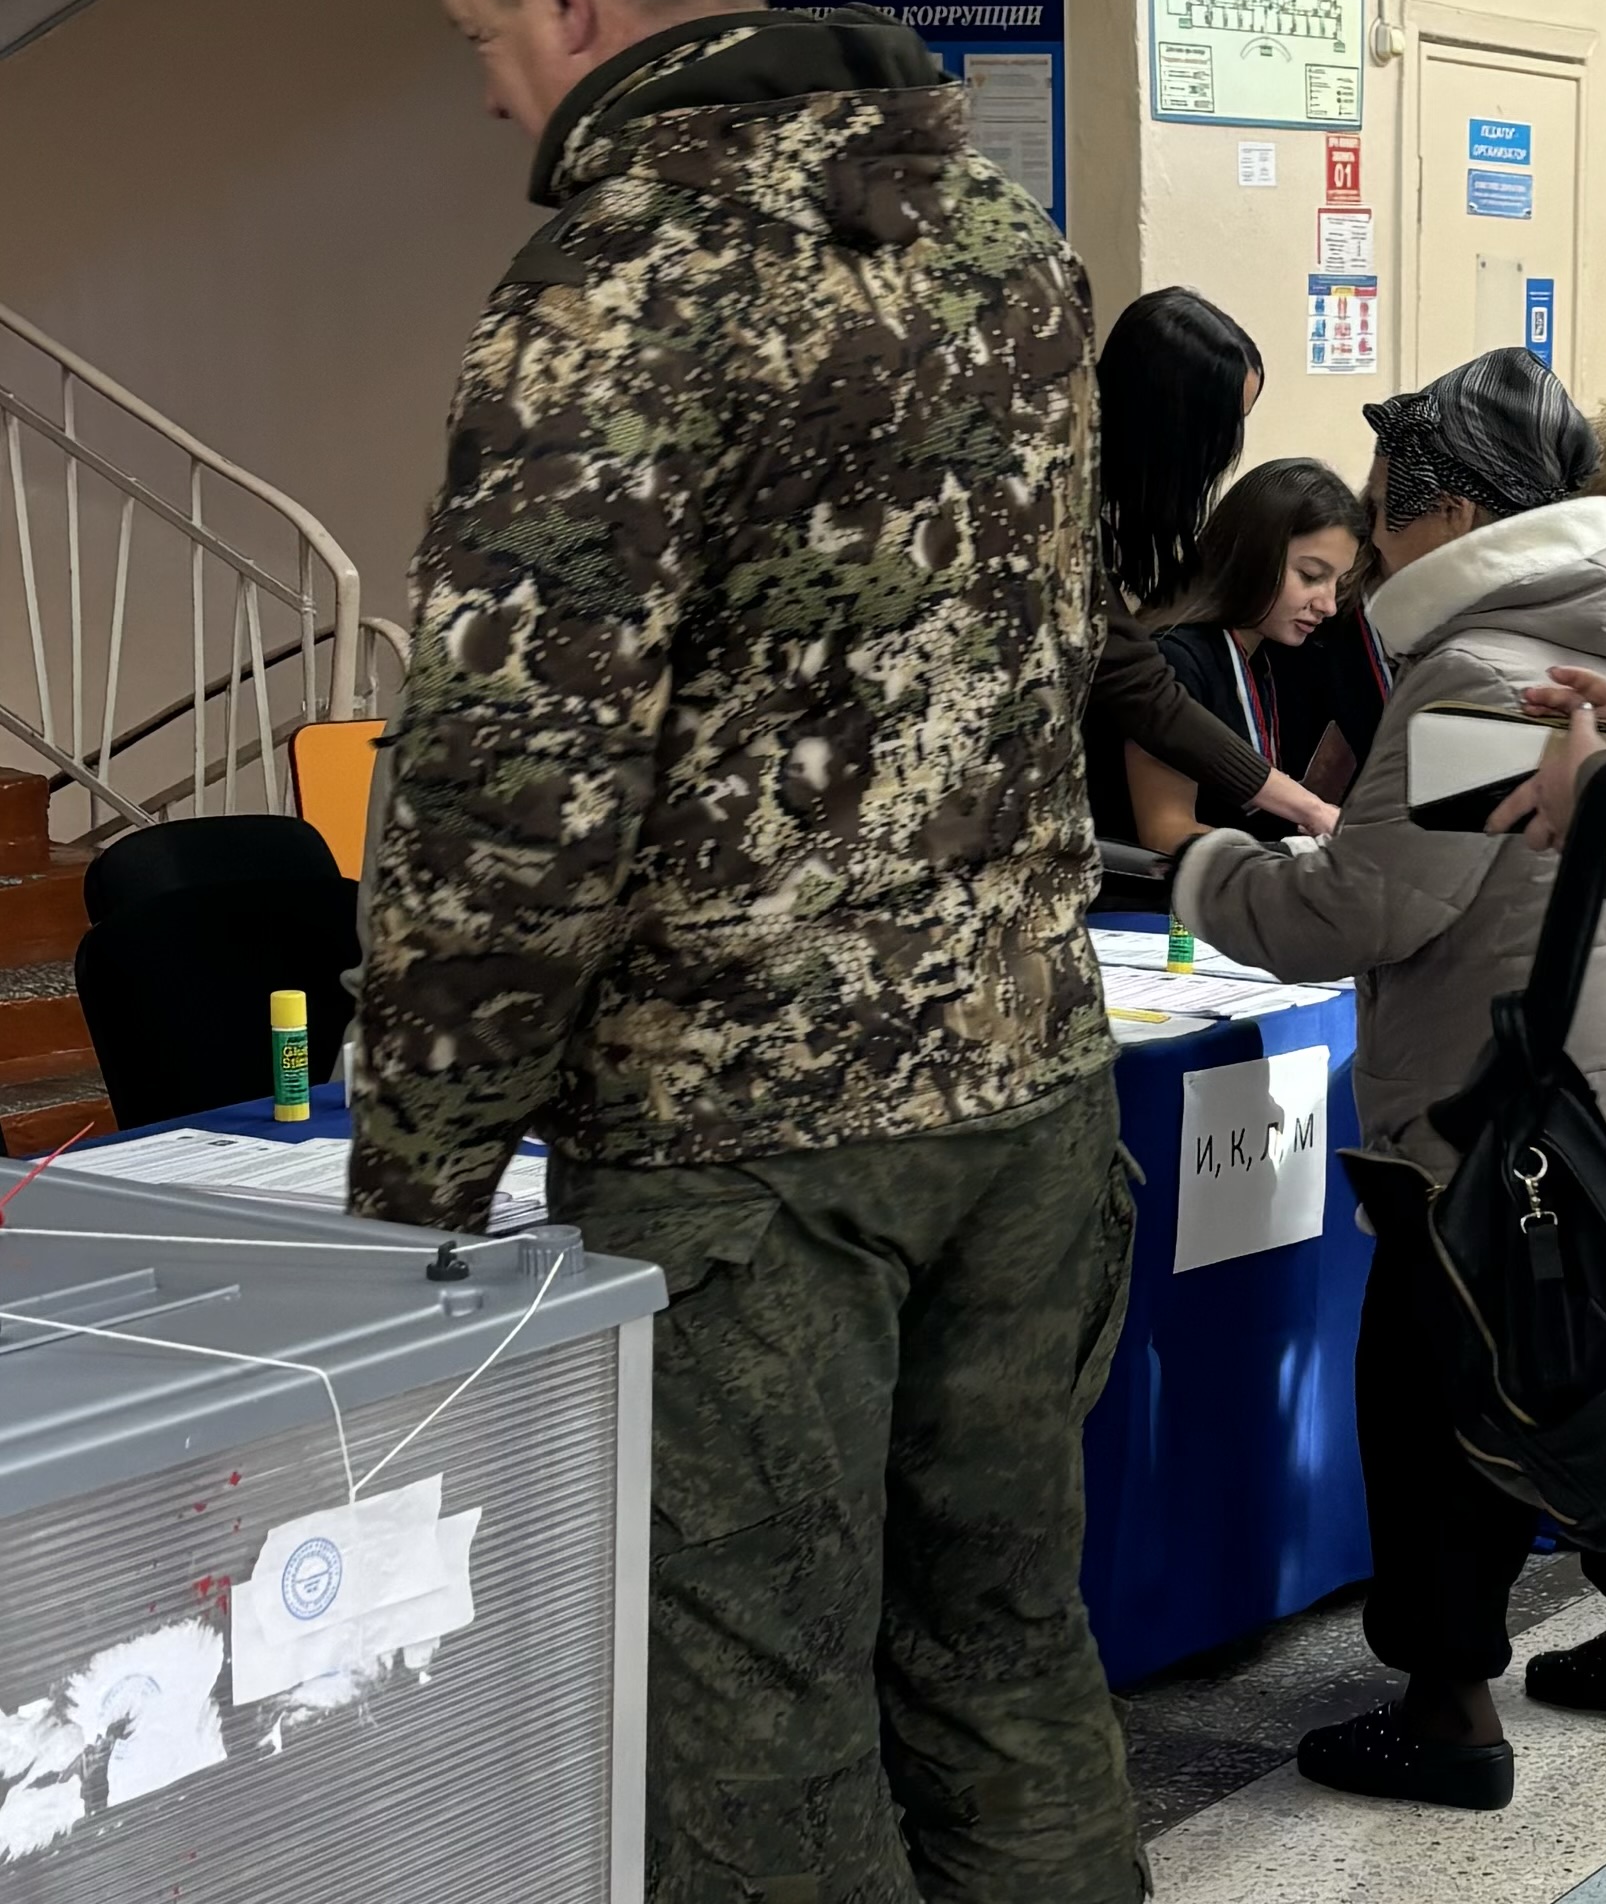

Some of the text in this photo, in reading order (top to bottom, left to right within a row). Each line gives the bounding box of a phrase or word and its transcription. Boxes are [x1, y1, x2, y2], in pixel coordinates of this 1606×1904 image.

[902, 5, 1044, 31] КОРРУПЦИИ
[1334, 163, 1352, 188] 01
[1196, 1134, 1221, 1178] И,
[1231, 1127, 1252, 1172] К,
[1293, 1112, 1314, 1153] М
